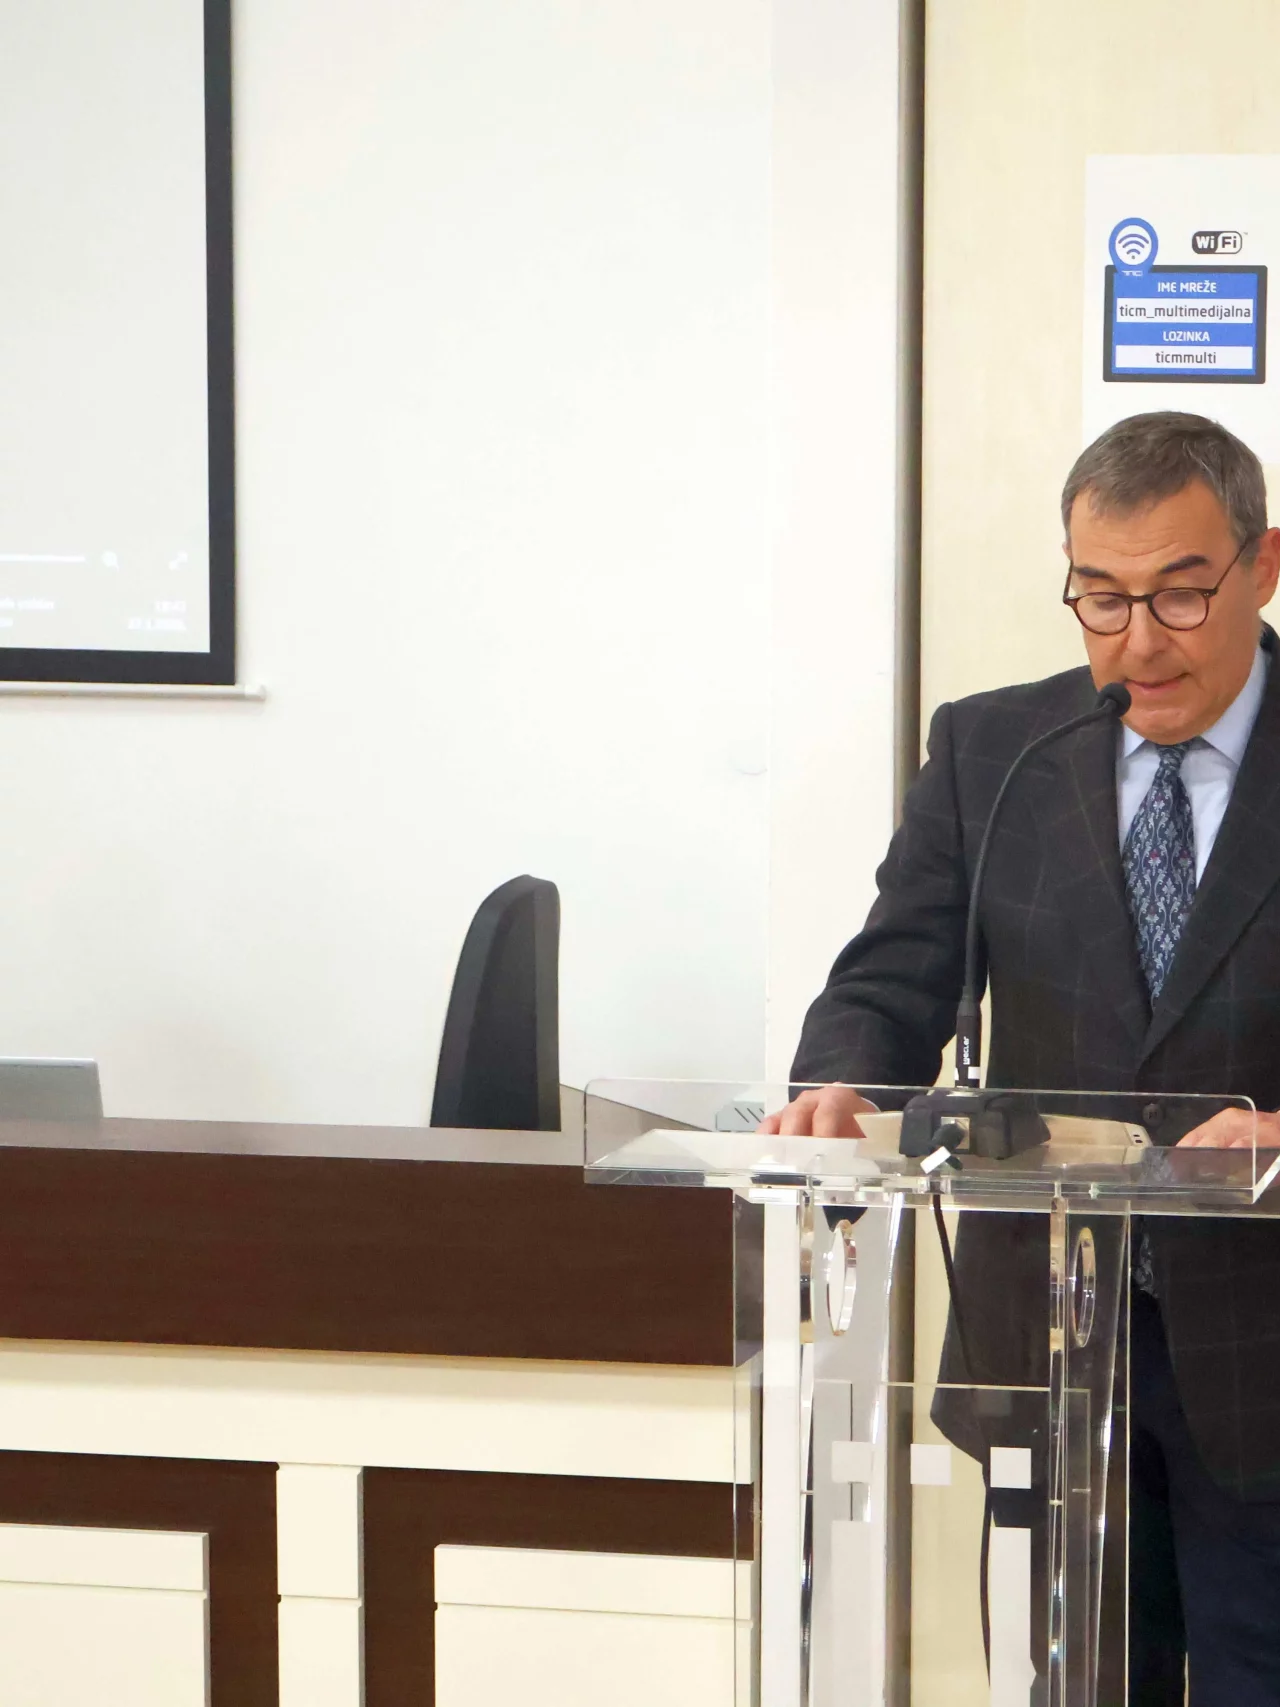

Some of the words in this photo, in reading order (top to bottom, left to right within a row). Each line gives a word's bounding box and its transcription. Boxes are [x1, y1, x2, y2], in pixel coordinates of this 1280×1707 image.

[1157, 282, 1177, 293] IME
[1180, 279, 1217, 294] MREŽE
[1119, 304, 1251, 321] ticm_multimedijalna
[1162, 330, 1211, 343] LOZINKA
[1155, 350, 1217, 364] ticmmulti
